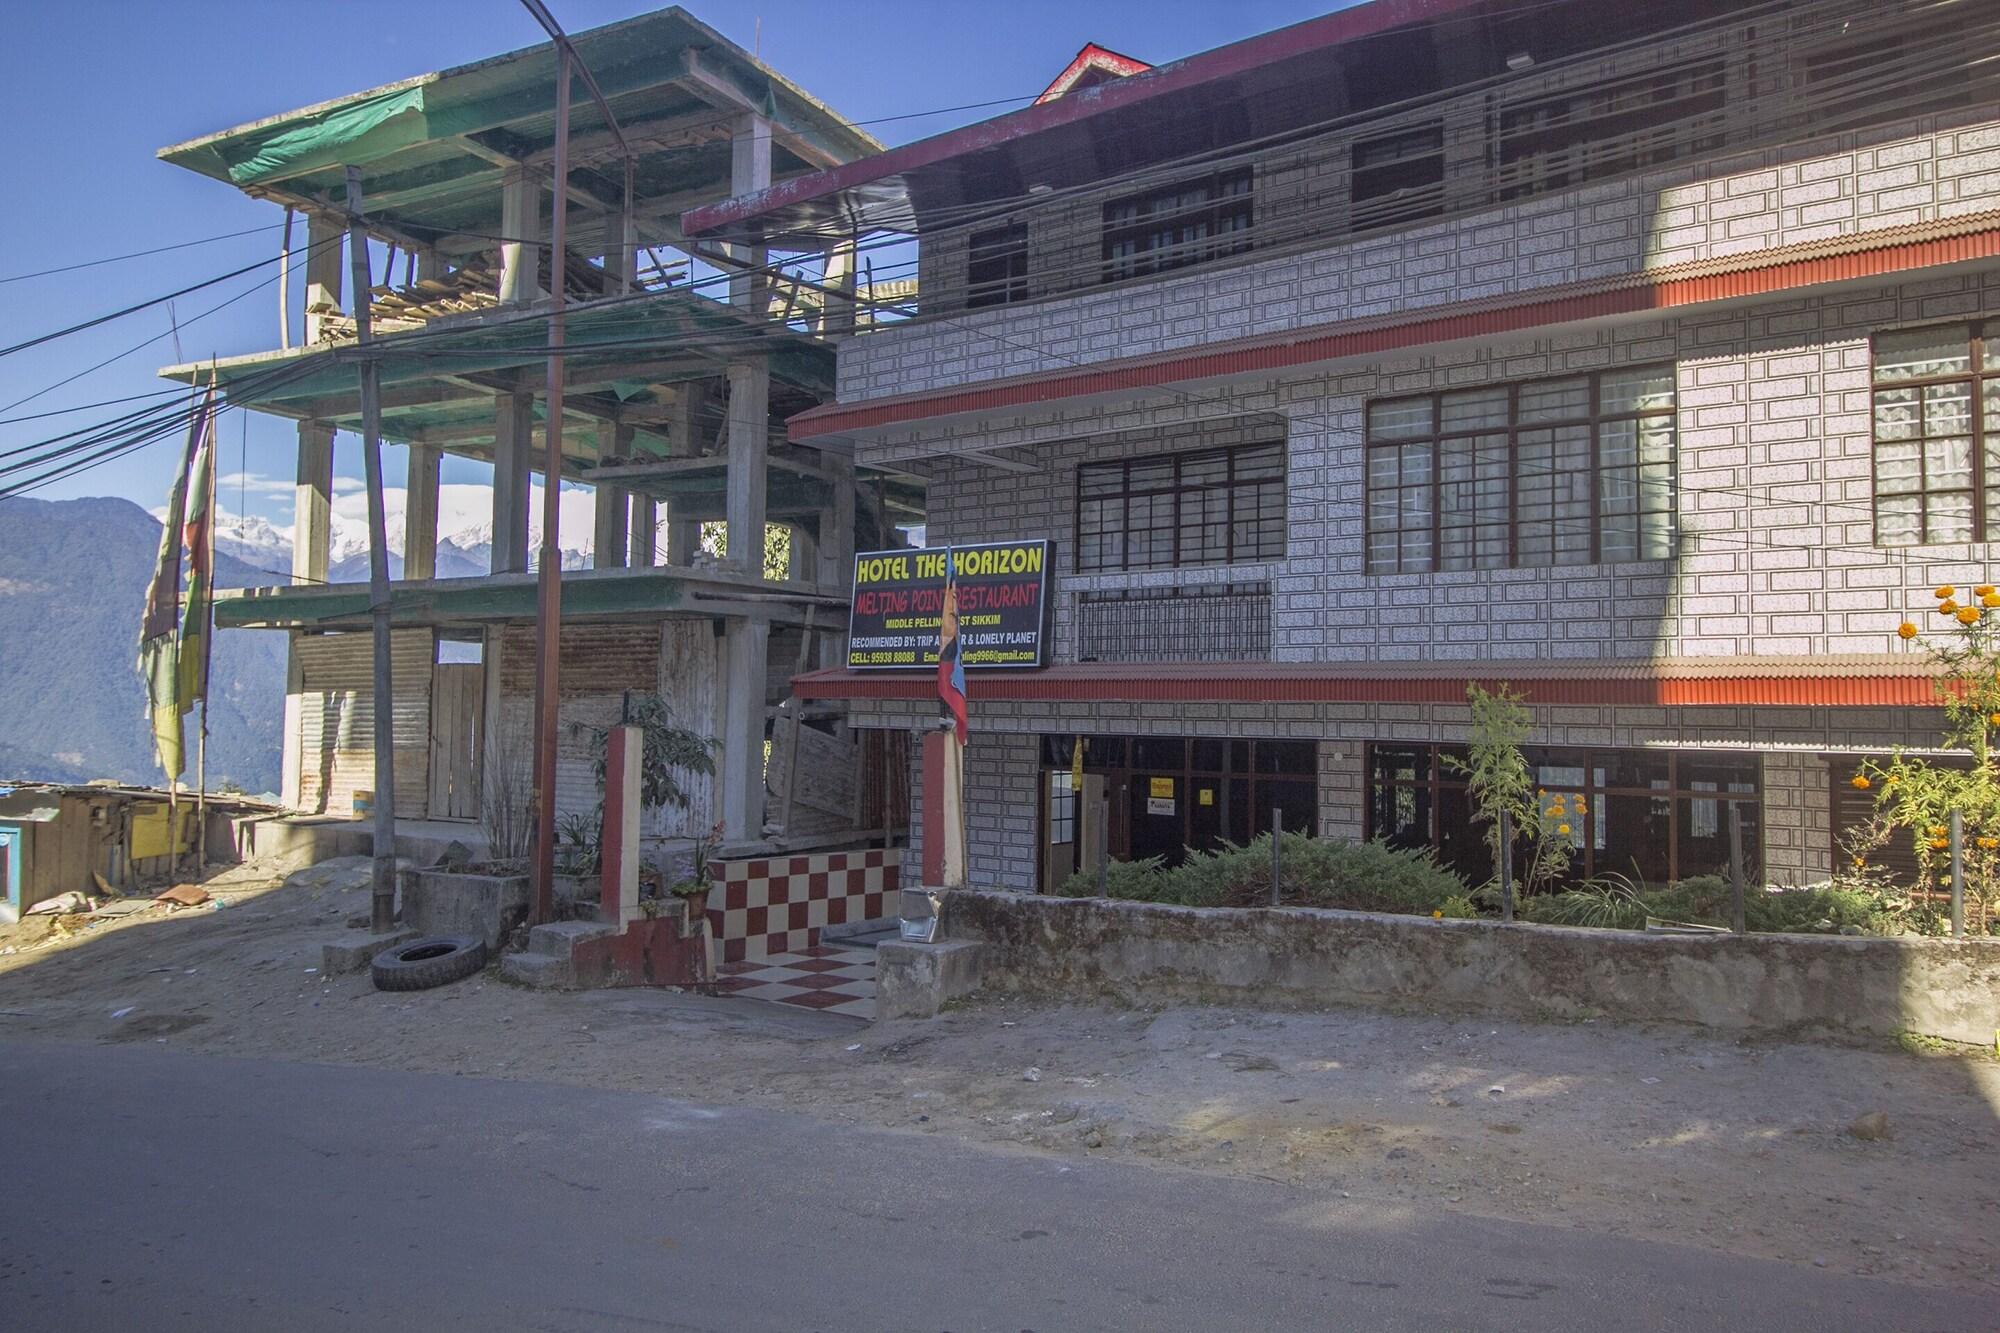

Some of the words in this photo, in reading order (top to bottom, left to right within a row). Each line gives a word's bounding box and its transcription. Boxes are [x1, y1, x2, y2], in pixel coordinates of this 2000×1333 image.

[857, 556, 910, 583] HOTEL
[916, 553, 947, 579] THE
[954, 547, 1042, 576] HORIZON
[855, 590, 908, 615] MELTING
[957, 583, 1039, 608] RESTAURANT
[885, 617, 913, 629] MIDDLE
[971, 614, 1001, 625] SIKKIM
[851, 634, 904, 648] RECOMMENDED
[904, 634, 916, 647] BY:
[917, 634, 933, 647] TRIP
[975, 632, 1006, 645] LONELY
[1007, 631, 1037, 644] PLANET
[850, 652, 870, 664] CELL:
